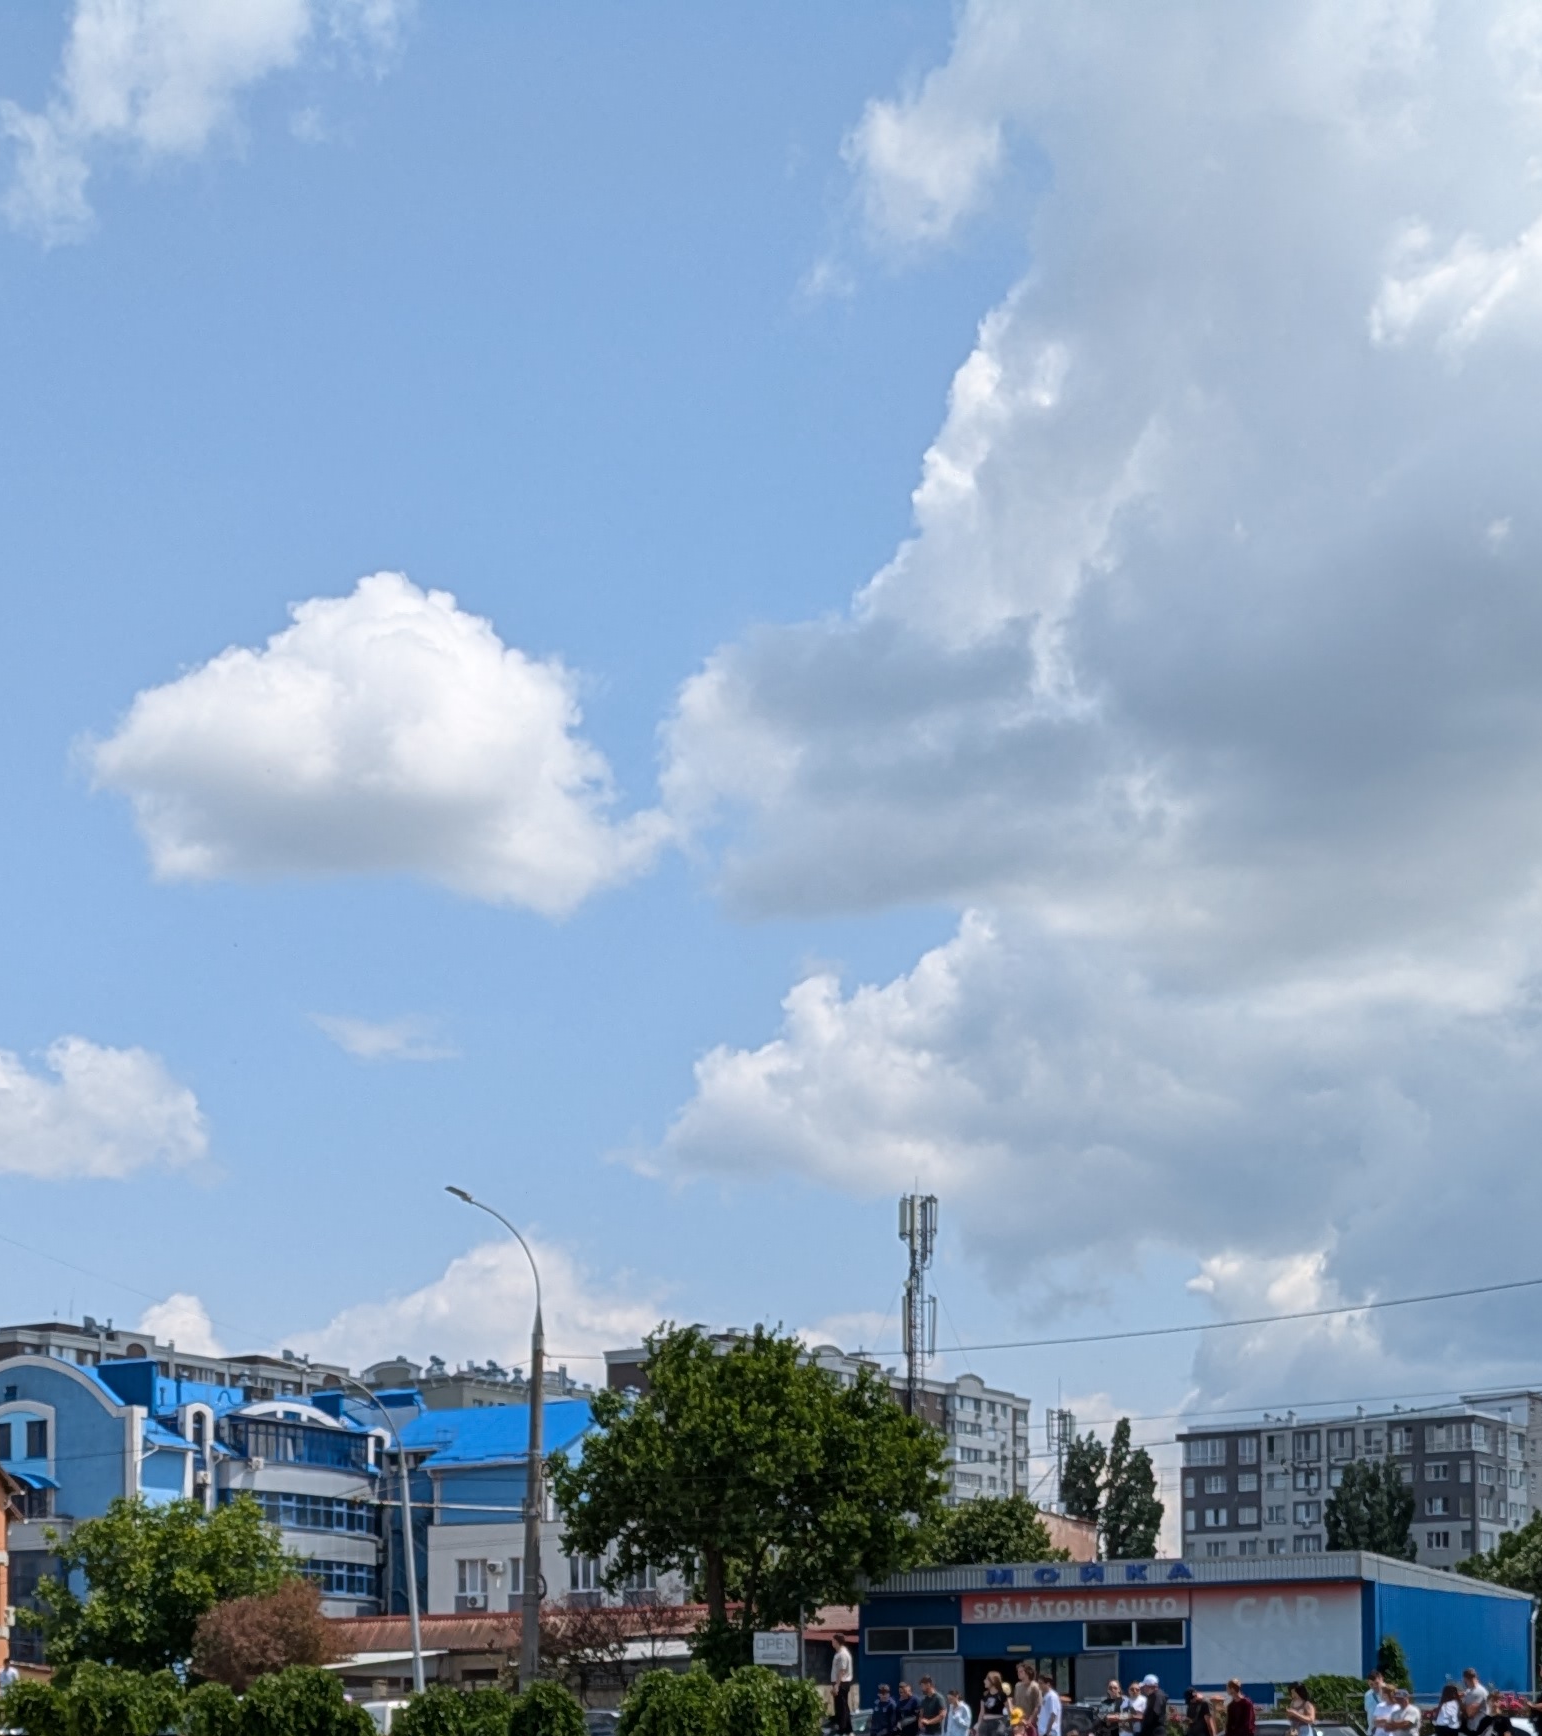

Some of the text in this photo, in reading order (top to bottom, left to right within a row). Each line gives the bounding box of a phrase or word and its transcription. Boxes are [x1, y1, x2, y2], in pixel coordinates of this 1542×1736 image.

[986, 1561, 1193, 1585] МОЙКА
[973, 1597, 1177, 1620] SPĂLĂTORIE AUTO
[1232, 1595, 1323, 1628] CAR
